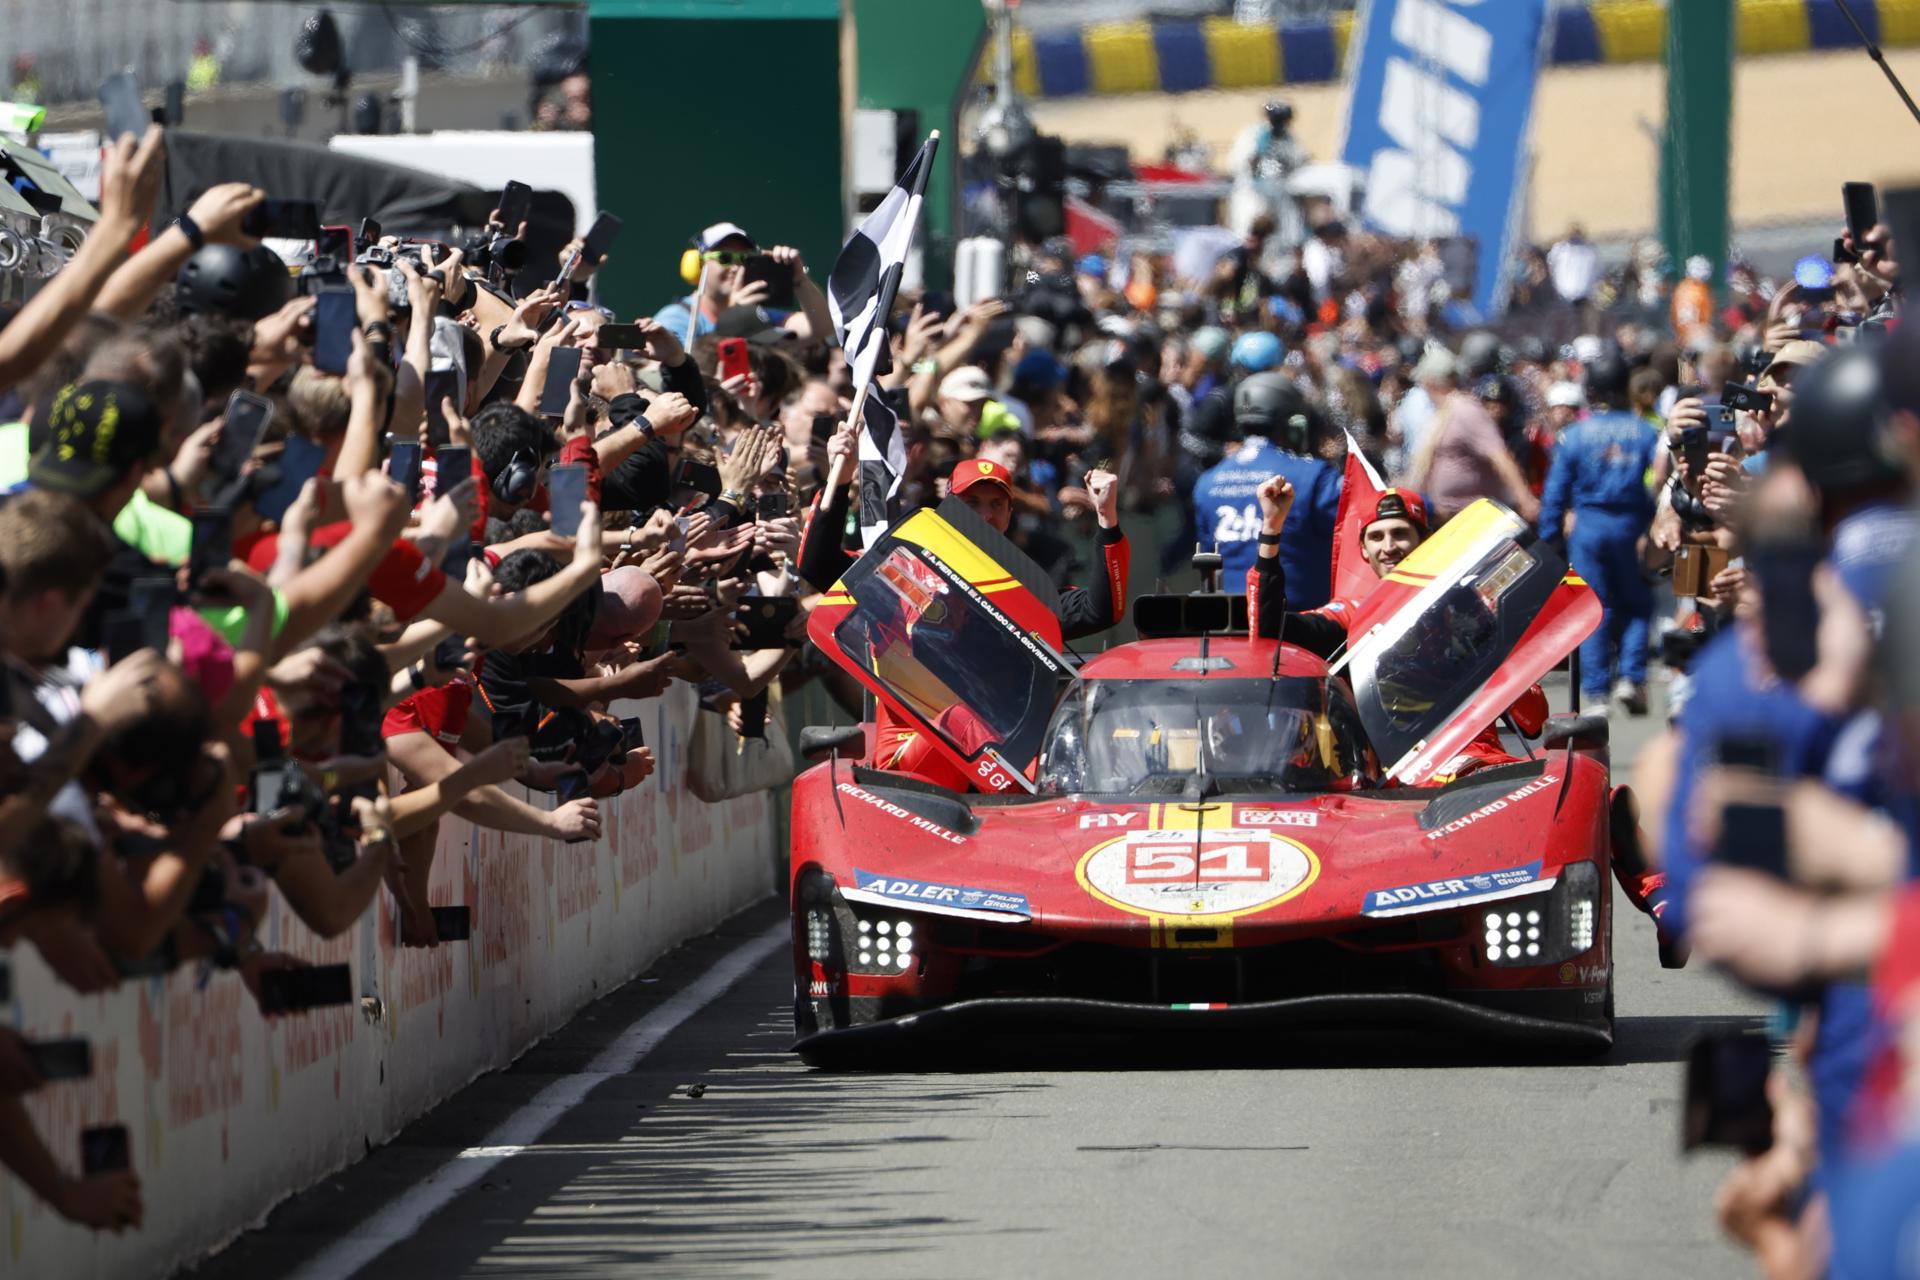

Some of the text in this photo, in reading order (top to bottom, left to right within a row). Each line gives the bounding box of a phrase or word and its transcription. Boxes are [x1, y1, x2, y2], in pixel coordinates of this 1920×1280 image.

[980, 601, 1009, 626] CALADO
[1020, 636, 1058, 672] GIOVINAZZI
[836, 782, 967, 845] RICHARD MILLE
[1426, 774, 1560, 840] RICHARD MILLE
[1079, 812, 1139, 829] HY
[1244, 816, 1311, 825] CAR
[1133, 845, 1262, 879] 51
[1492, 870, 1528, 880] PELZER
[1498, 875, 1533, 886] GROUP
[860, 879, 960, 901] ADLER
[988, 893, 1024, 904] PELZER
[1375, 879, 1469, 906] ADLER
[983, 900, 1019, 910] GROUP
